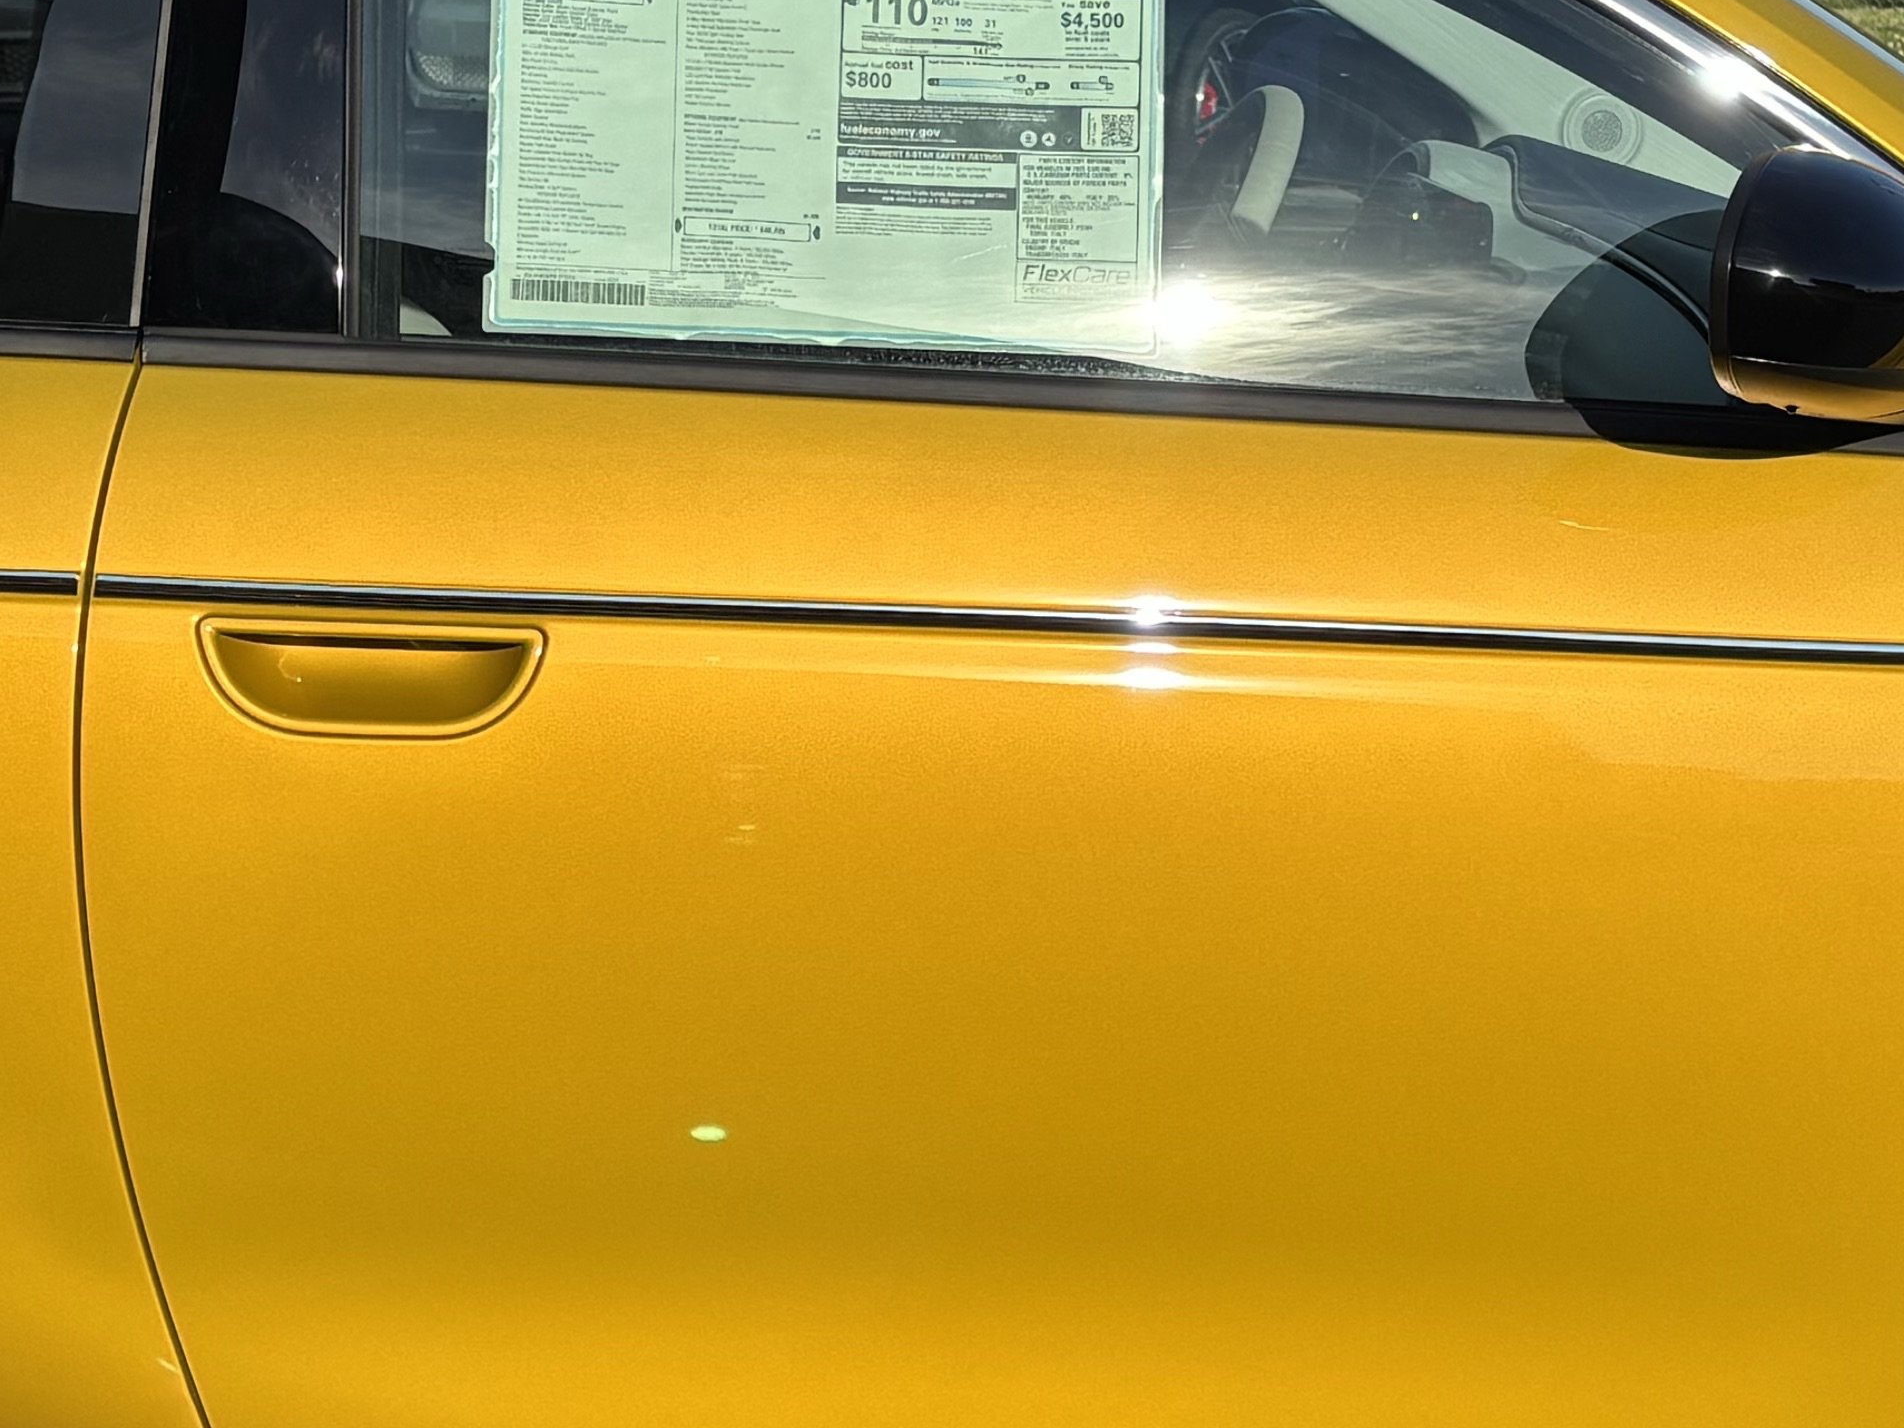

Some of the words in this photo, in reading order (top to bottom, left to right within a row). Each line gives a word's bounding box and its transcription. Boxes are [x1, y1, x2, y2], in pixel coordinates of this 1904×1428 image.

[1079, 0, 1111, 9] save
[932, 16, 949, 25] 121
[1061, 12, 1124, 30] $4,500
[885, 60, 914, 70] cost
[845, 71, 892, 88] $800
[840, 124, 941, 138] fueleconomy.gov
[1023, 264, 1130, 284] FlexCare
